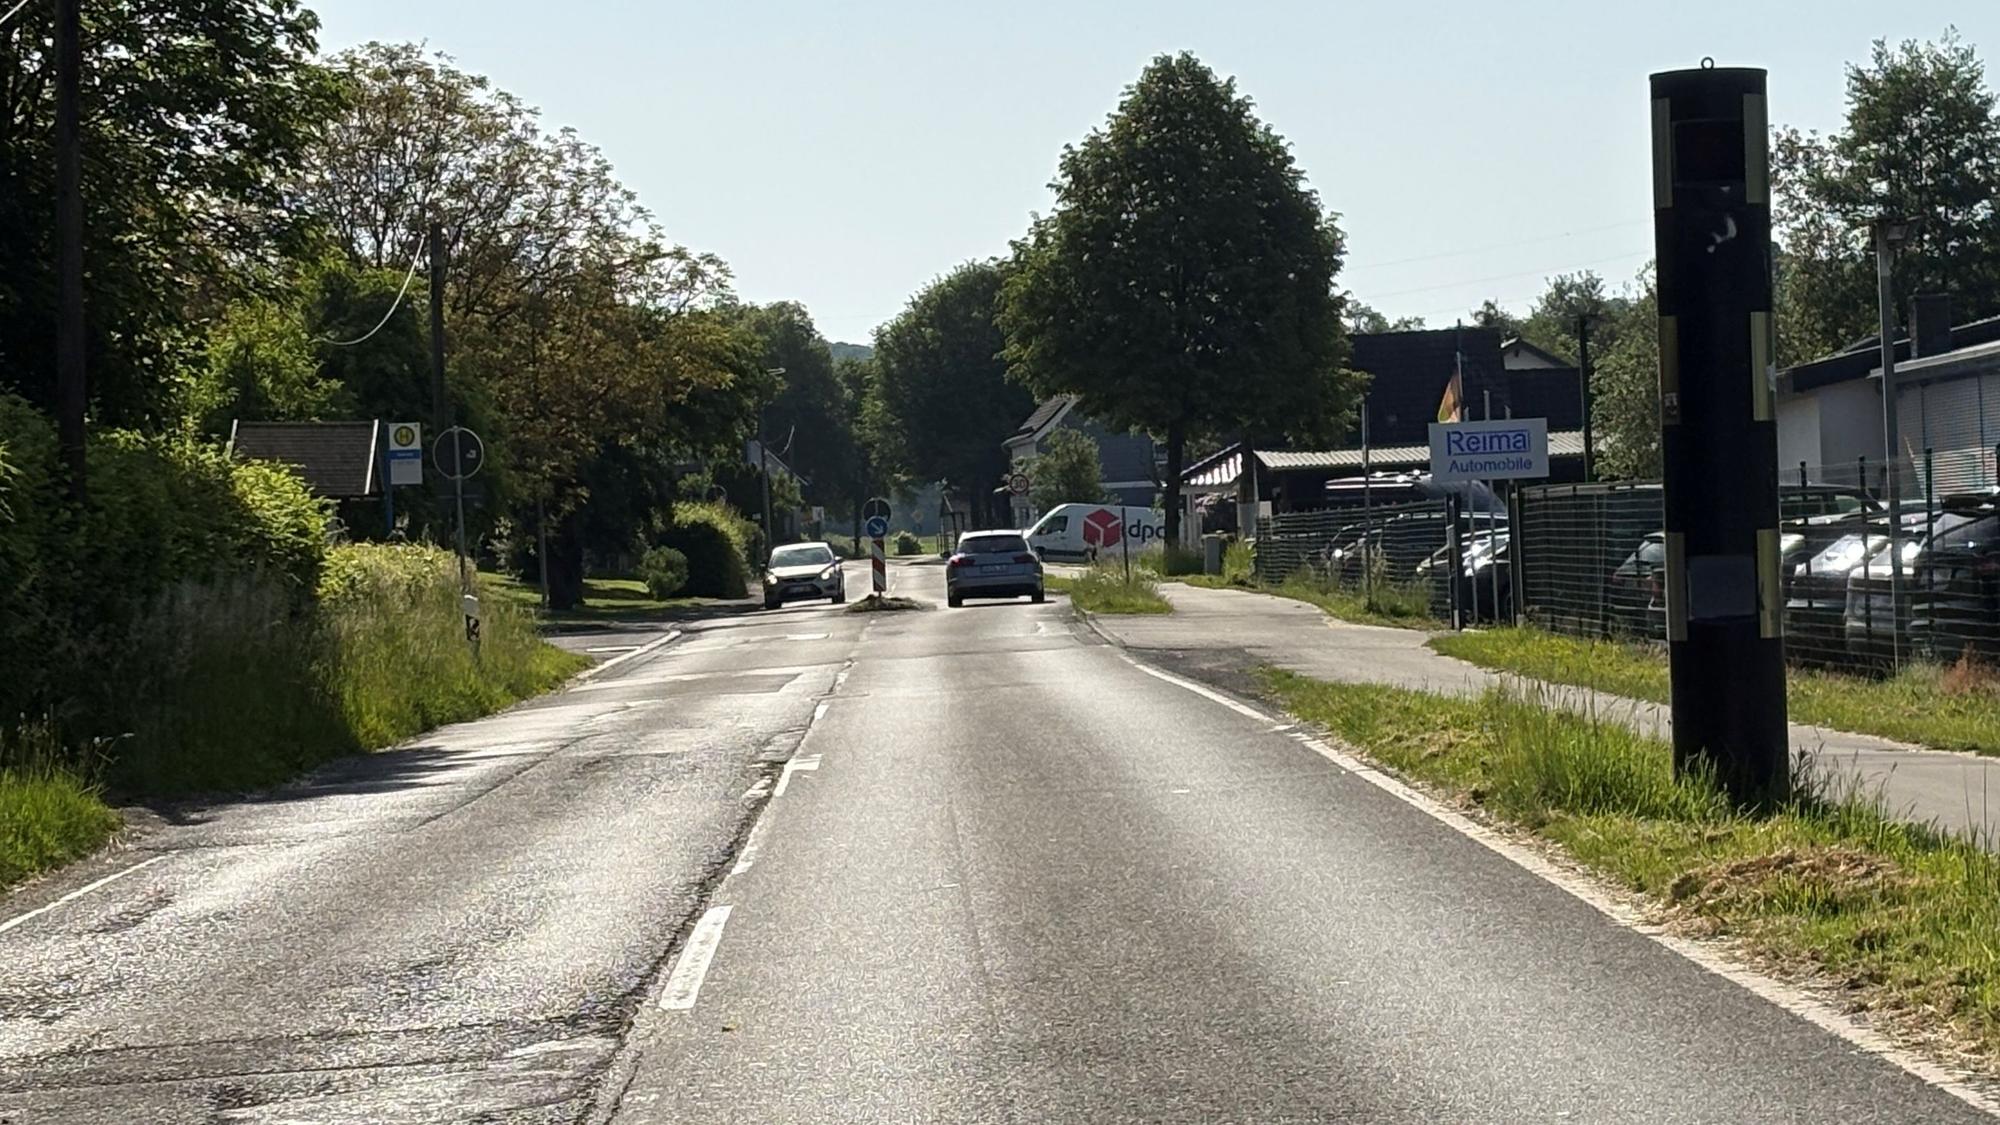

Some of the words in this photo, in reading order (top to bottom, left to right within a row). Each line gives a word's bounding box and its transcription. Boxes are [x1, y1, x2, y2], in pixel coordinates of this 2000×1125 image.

[1446, 431, 1528, 456] Reima
[1449, 457, 1532, 473] Automobile
[1013, 478, 1026, 490] 30
